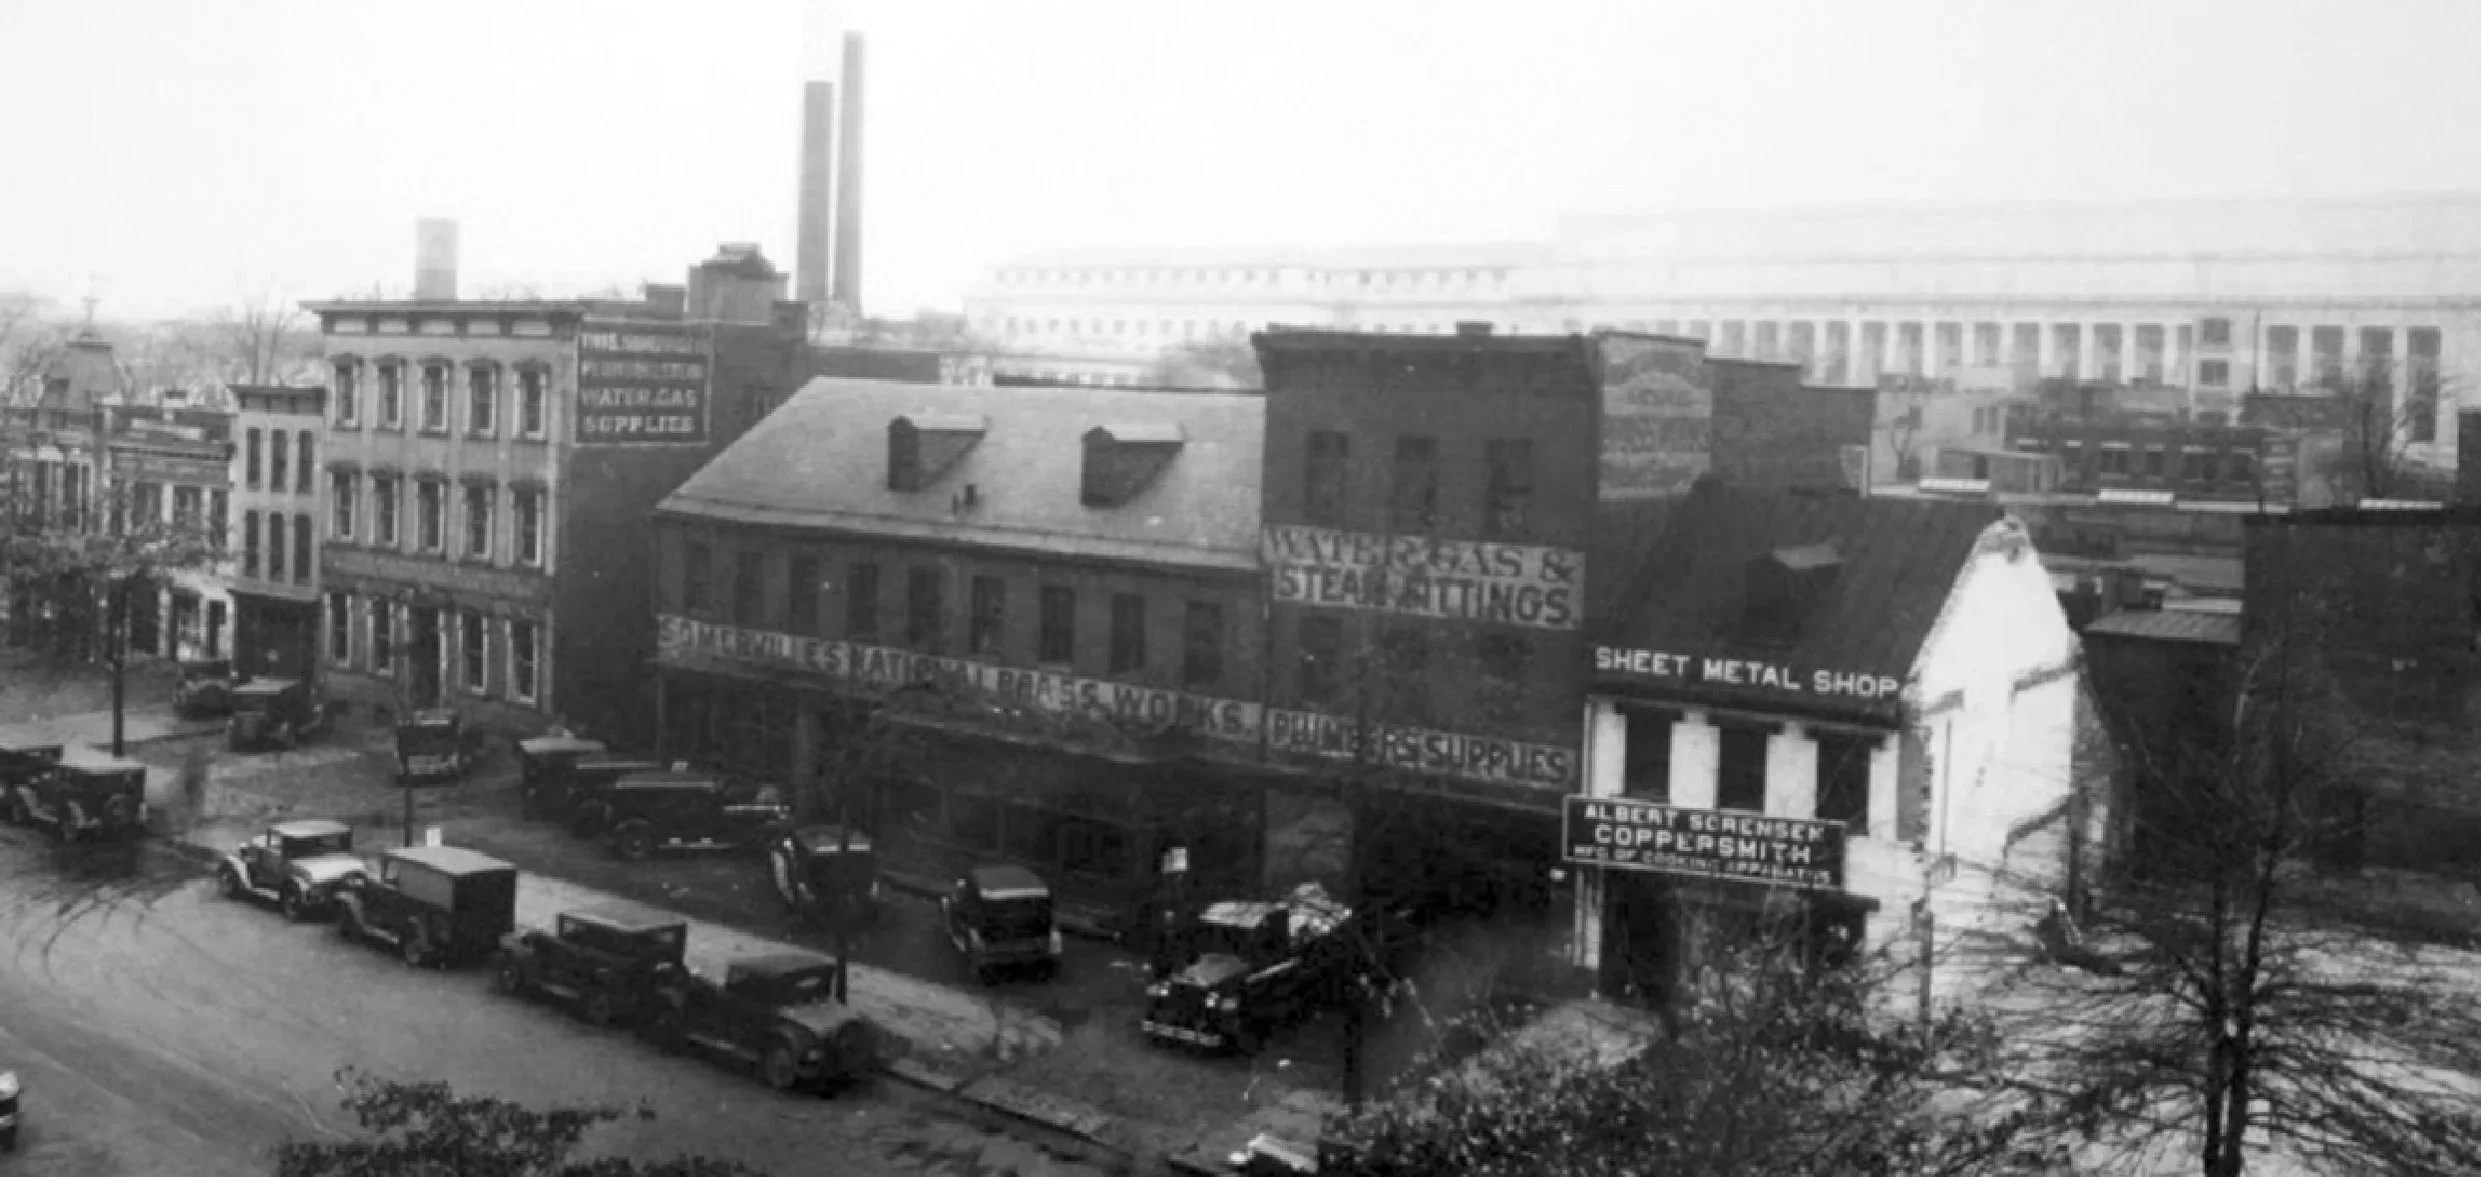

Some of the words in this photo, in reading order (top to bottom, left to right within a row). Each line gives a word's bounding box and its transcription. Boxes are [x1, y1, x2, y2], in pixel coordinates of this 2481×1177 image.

[582, 415, 695, 434] SUPPLIES
[1540, 549, 1579, 584] &
[1595, 646, 1691, 677] SHEET
[1703, 658, 1801, 691] METAL
[1813, 669, 1899, 698] SHOP
[1585, 803, 1680, 828] ALBERT
[1689, 813, 1826, 843] SORENSEN
[1594, 823, 1812, 865] COPPERSMITH
